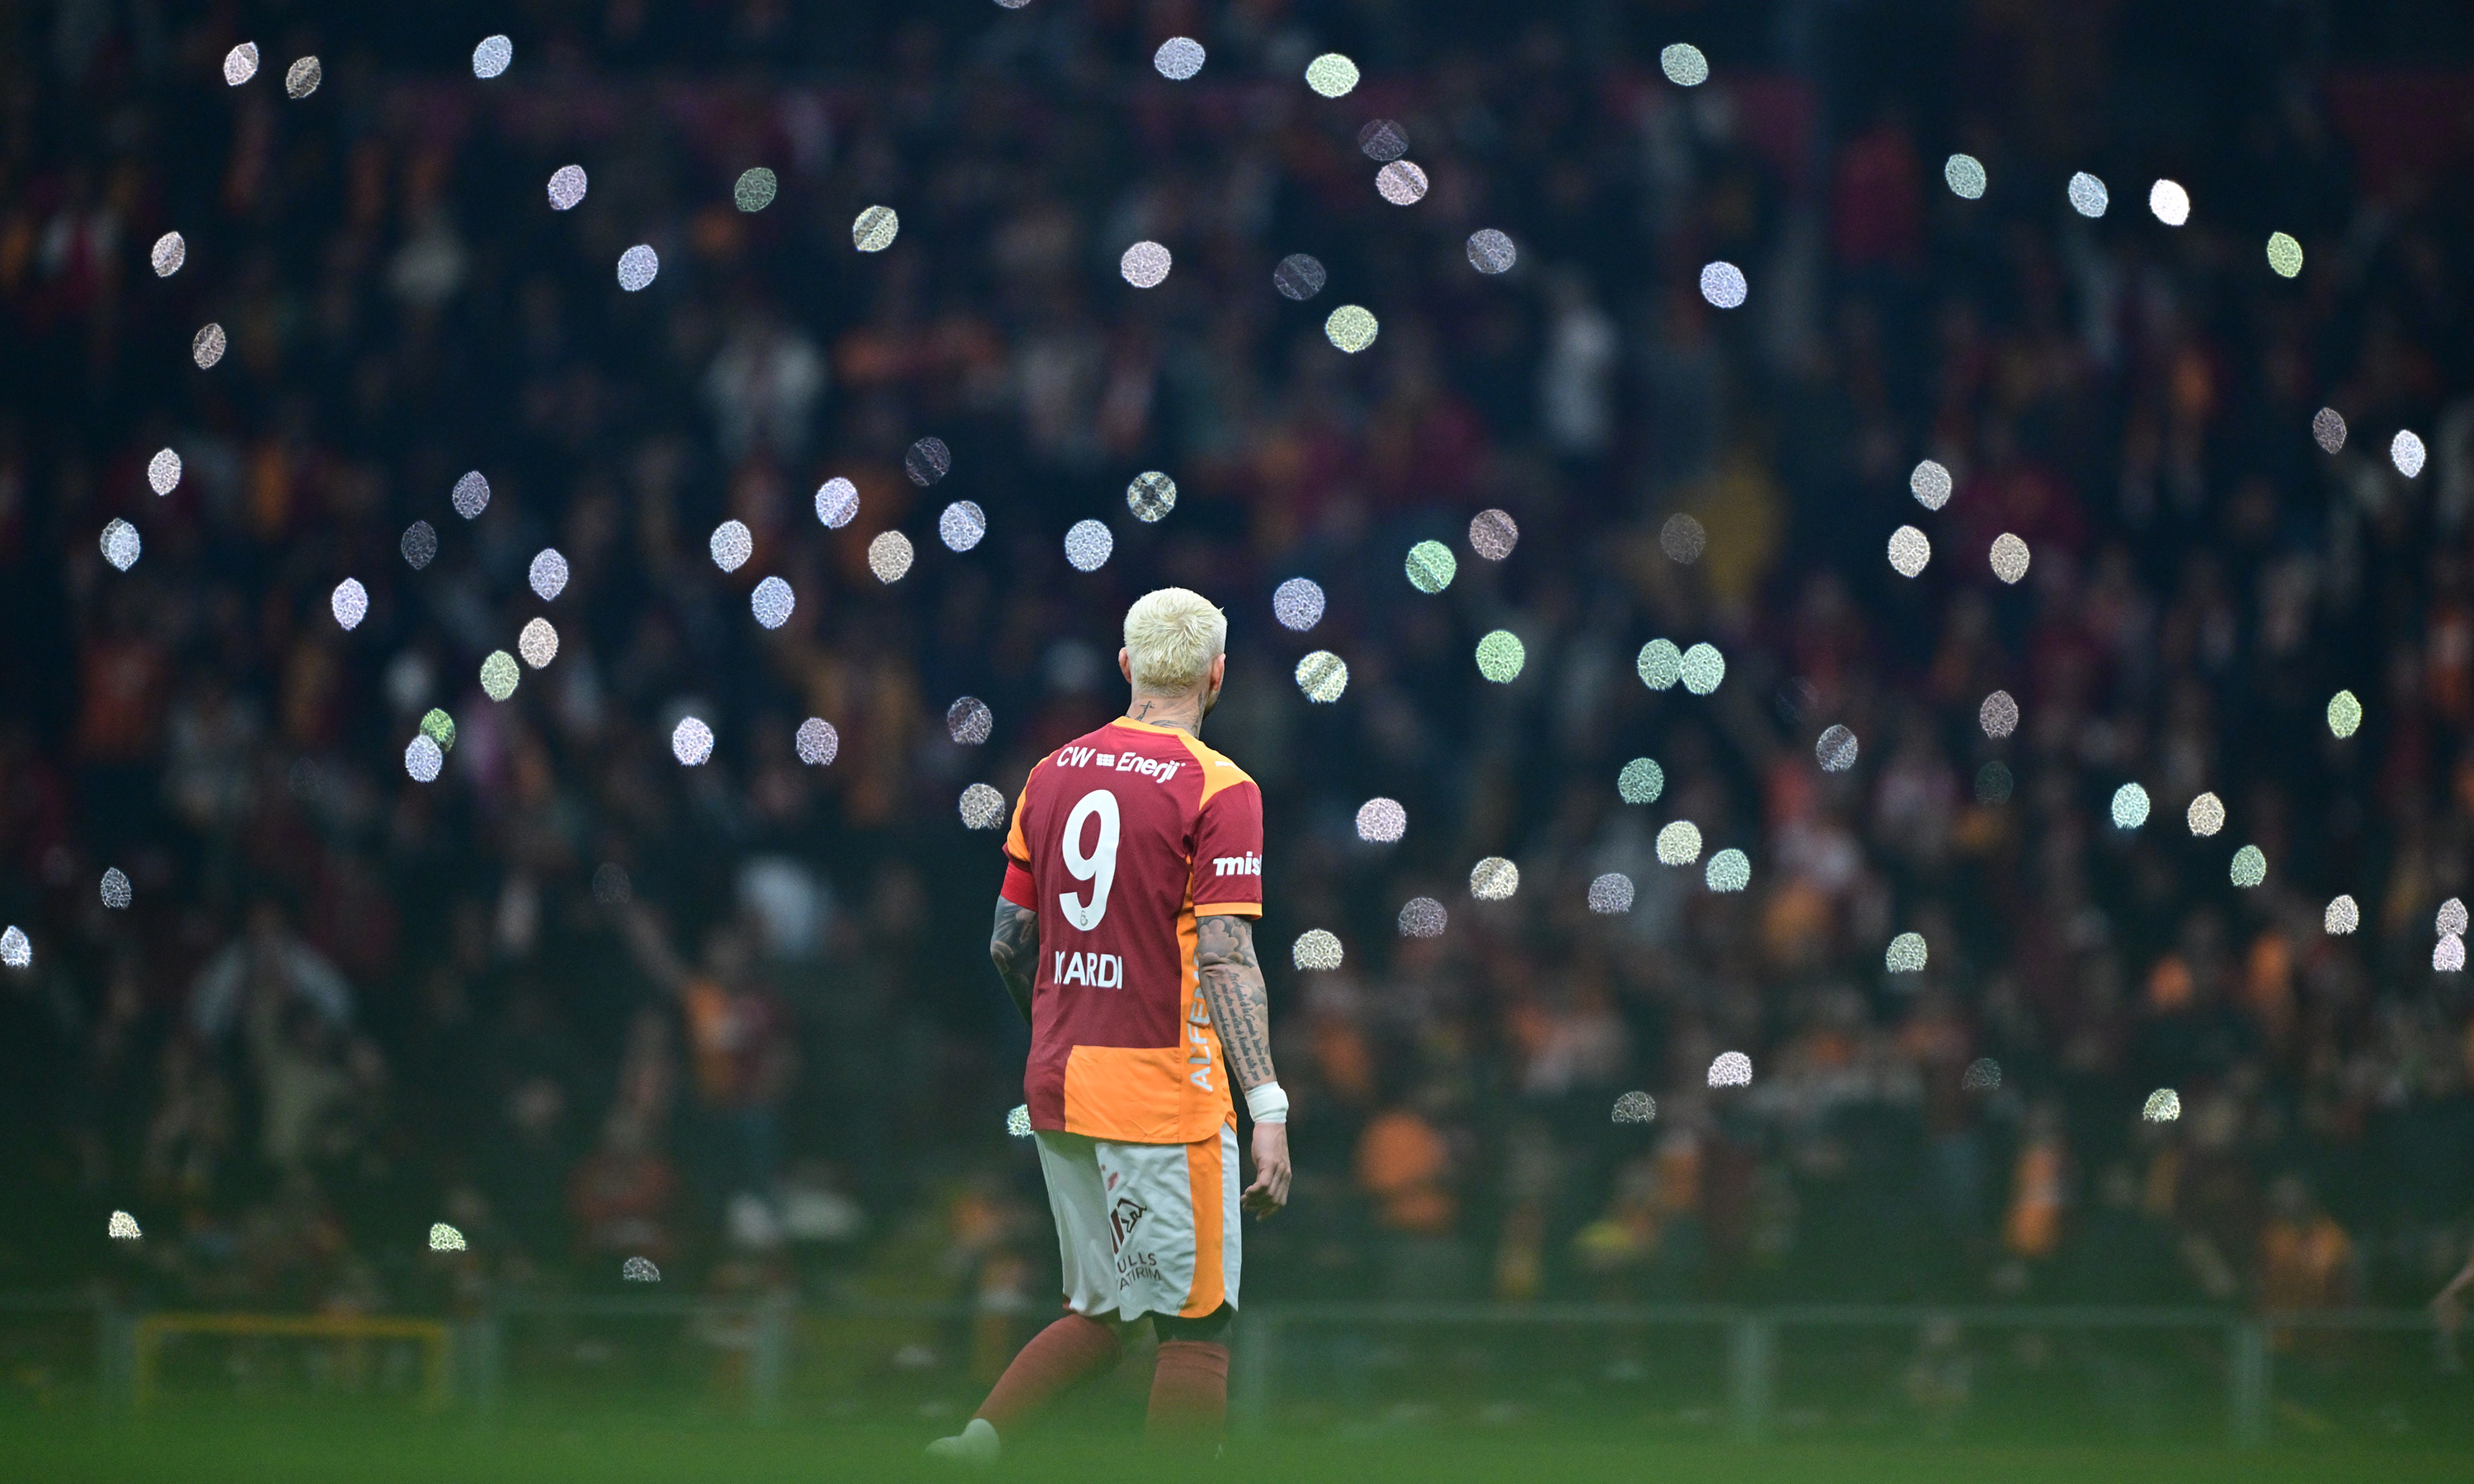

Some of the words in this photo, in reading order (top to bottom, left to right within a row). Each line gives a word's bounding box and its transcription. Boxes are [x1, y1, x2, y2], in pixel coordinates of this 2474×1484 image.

[1056, 746, 1096, 768] CW
[1115, 752, 1180, 783] Enerji
[1059, 789, 1120, 931] 9
[1212, 851, 1262, 876] mis
[1188, 946, 1214, 1092] ALFE
[1116, 1266, 1161, 1290] ATIRIM
[1117, 1252, 1157, 1273] ULLS
